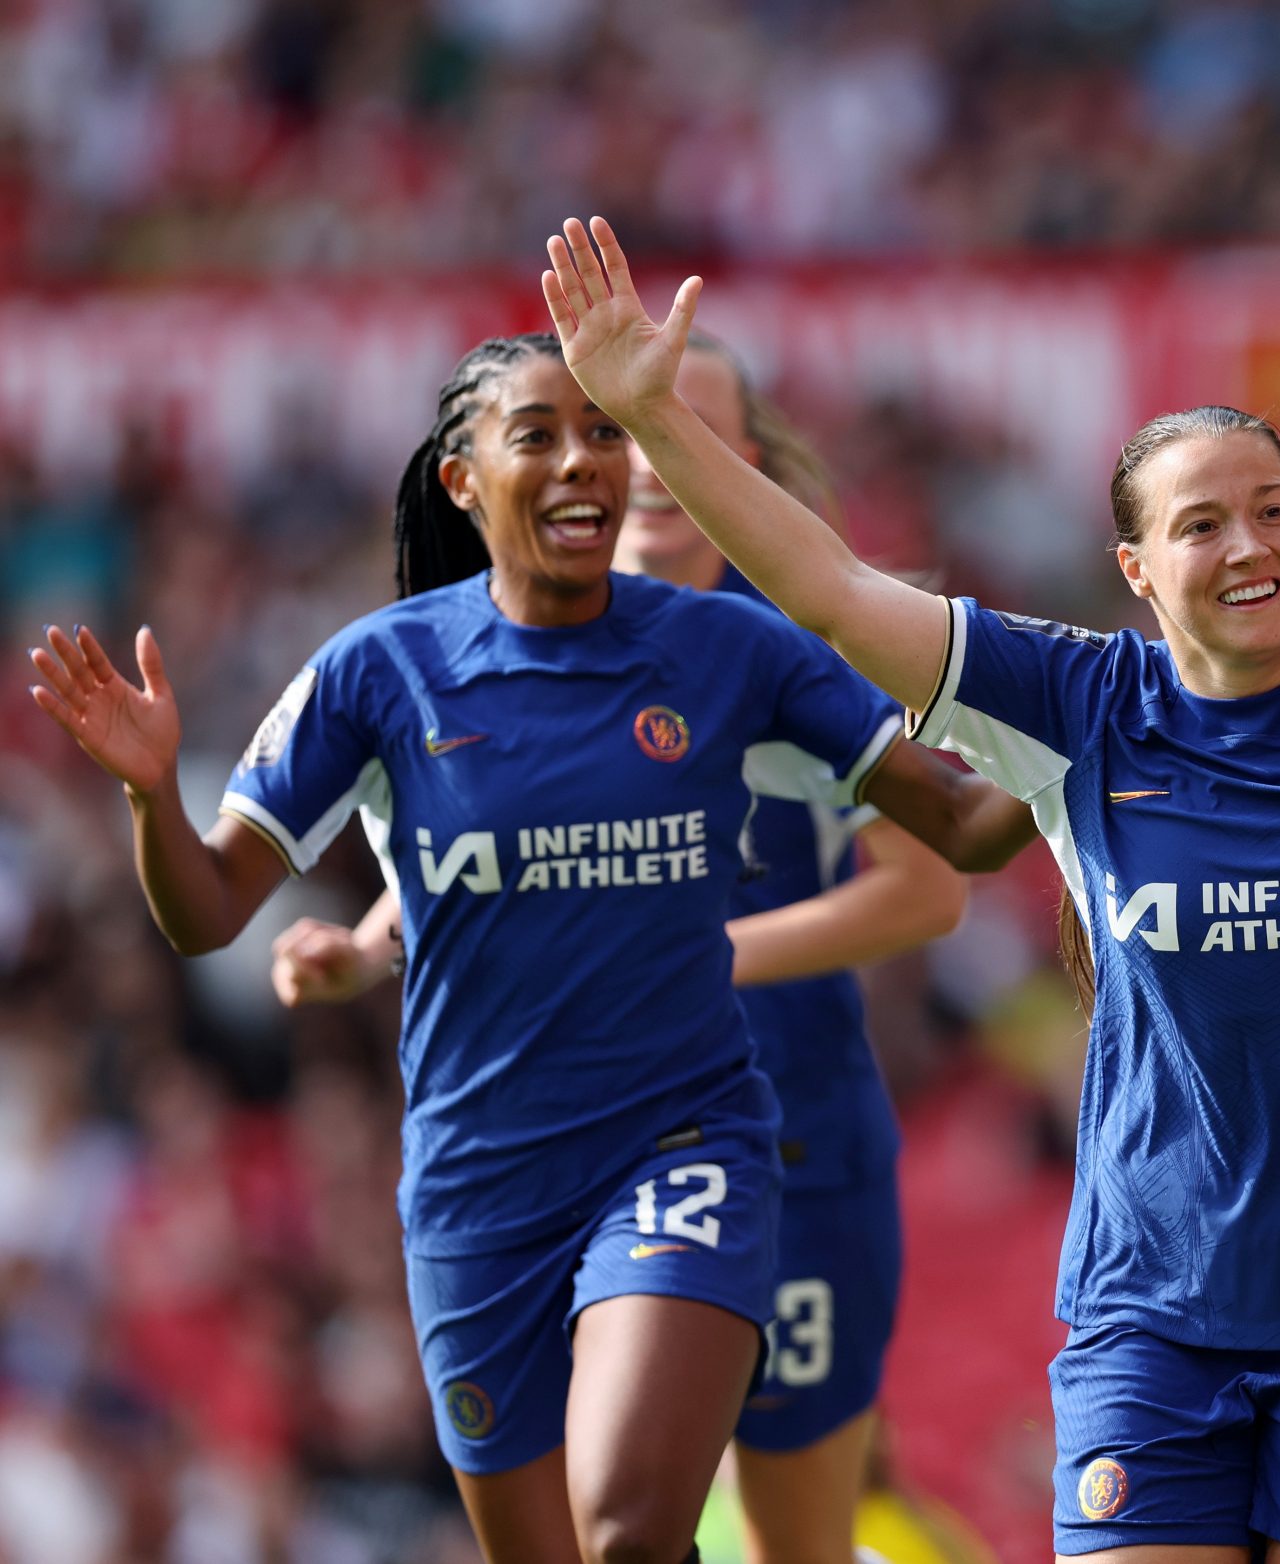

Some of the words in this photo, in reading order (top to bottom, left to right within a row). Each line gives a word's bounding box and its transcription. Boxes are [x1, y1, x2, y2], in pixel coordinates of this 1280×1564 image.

[519, 811, 705, 859] INFINITE
[518, 846, 708, 890] ATHLETE
[635, 1164, 727, 1248] 12
